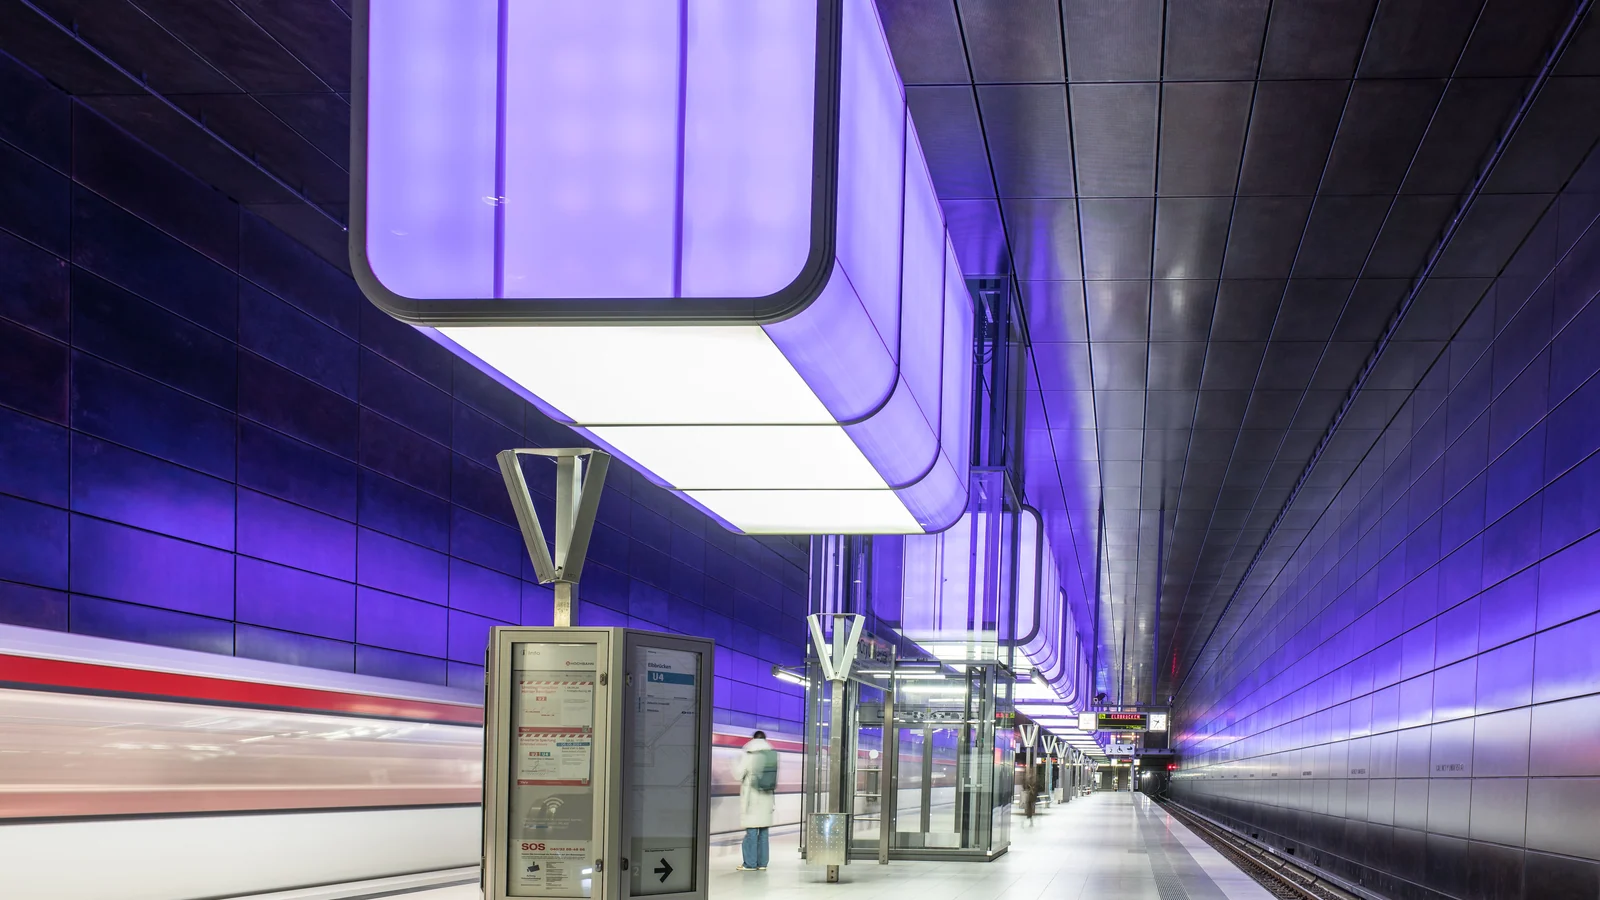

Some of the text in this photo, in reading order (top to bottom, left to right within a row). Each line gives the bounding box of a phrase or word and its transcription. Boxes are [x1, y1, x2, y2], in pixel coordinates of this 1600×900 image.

[652, 672, 664, 681] U4
[521, 843, 546, 851] SOS
[633, 866, 640, 876] 2
